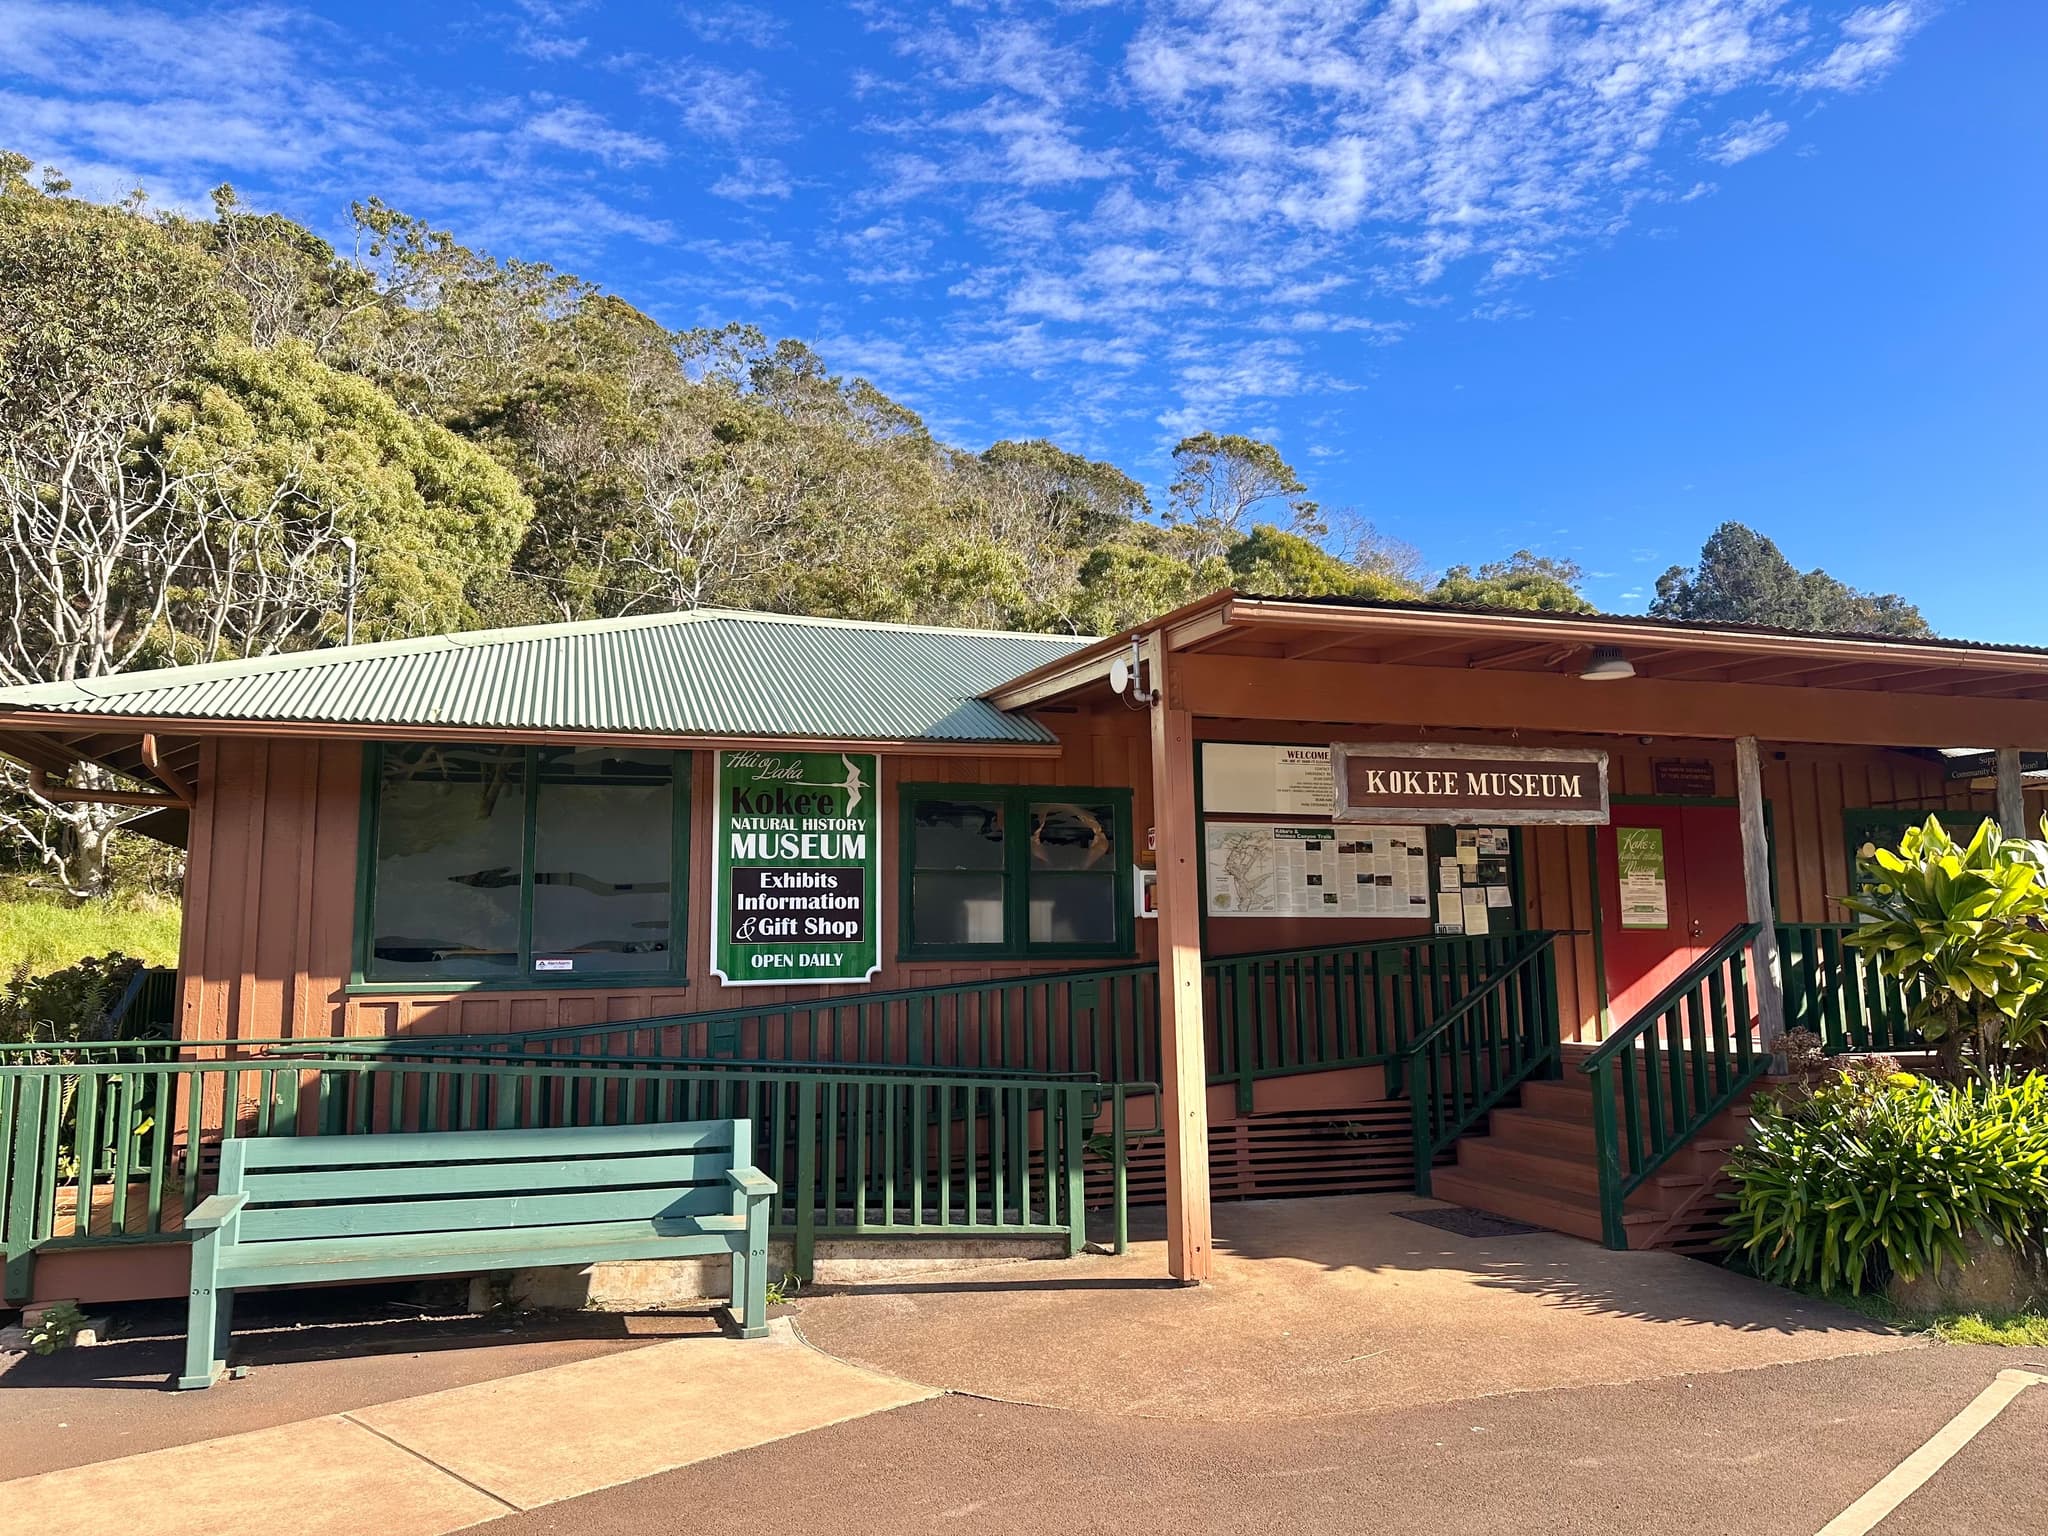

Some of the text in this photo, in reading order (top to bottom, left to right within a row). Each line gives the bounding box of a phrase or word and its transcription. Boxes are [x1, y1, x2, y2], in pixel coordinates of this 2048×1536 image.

[1287, 750, 1330, 760] WELCOME
[1366, 770, 1583, 798] KOKEE MUSEUM
[731, 817, 867, 831] NATURAL HISTORY
[731, 833, 866, 859] MUSEUM
[760, 872, 838, 889] Exhibits
[737, 892, 860, 911] Information
[736, 916, 858, 942] & Gift Shop
[751, 953, 844, 968] OPEN DAILY
